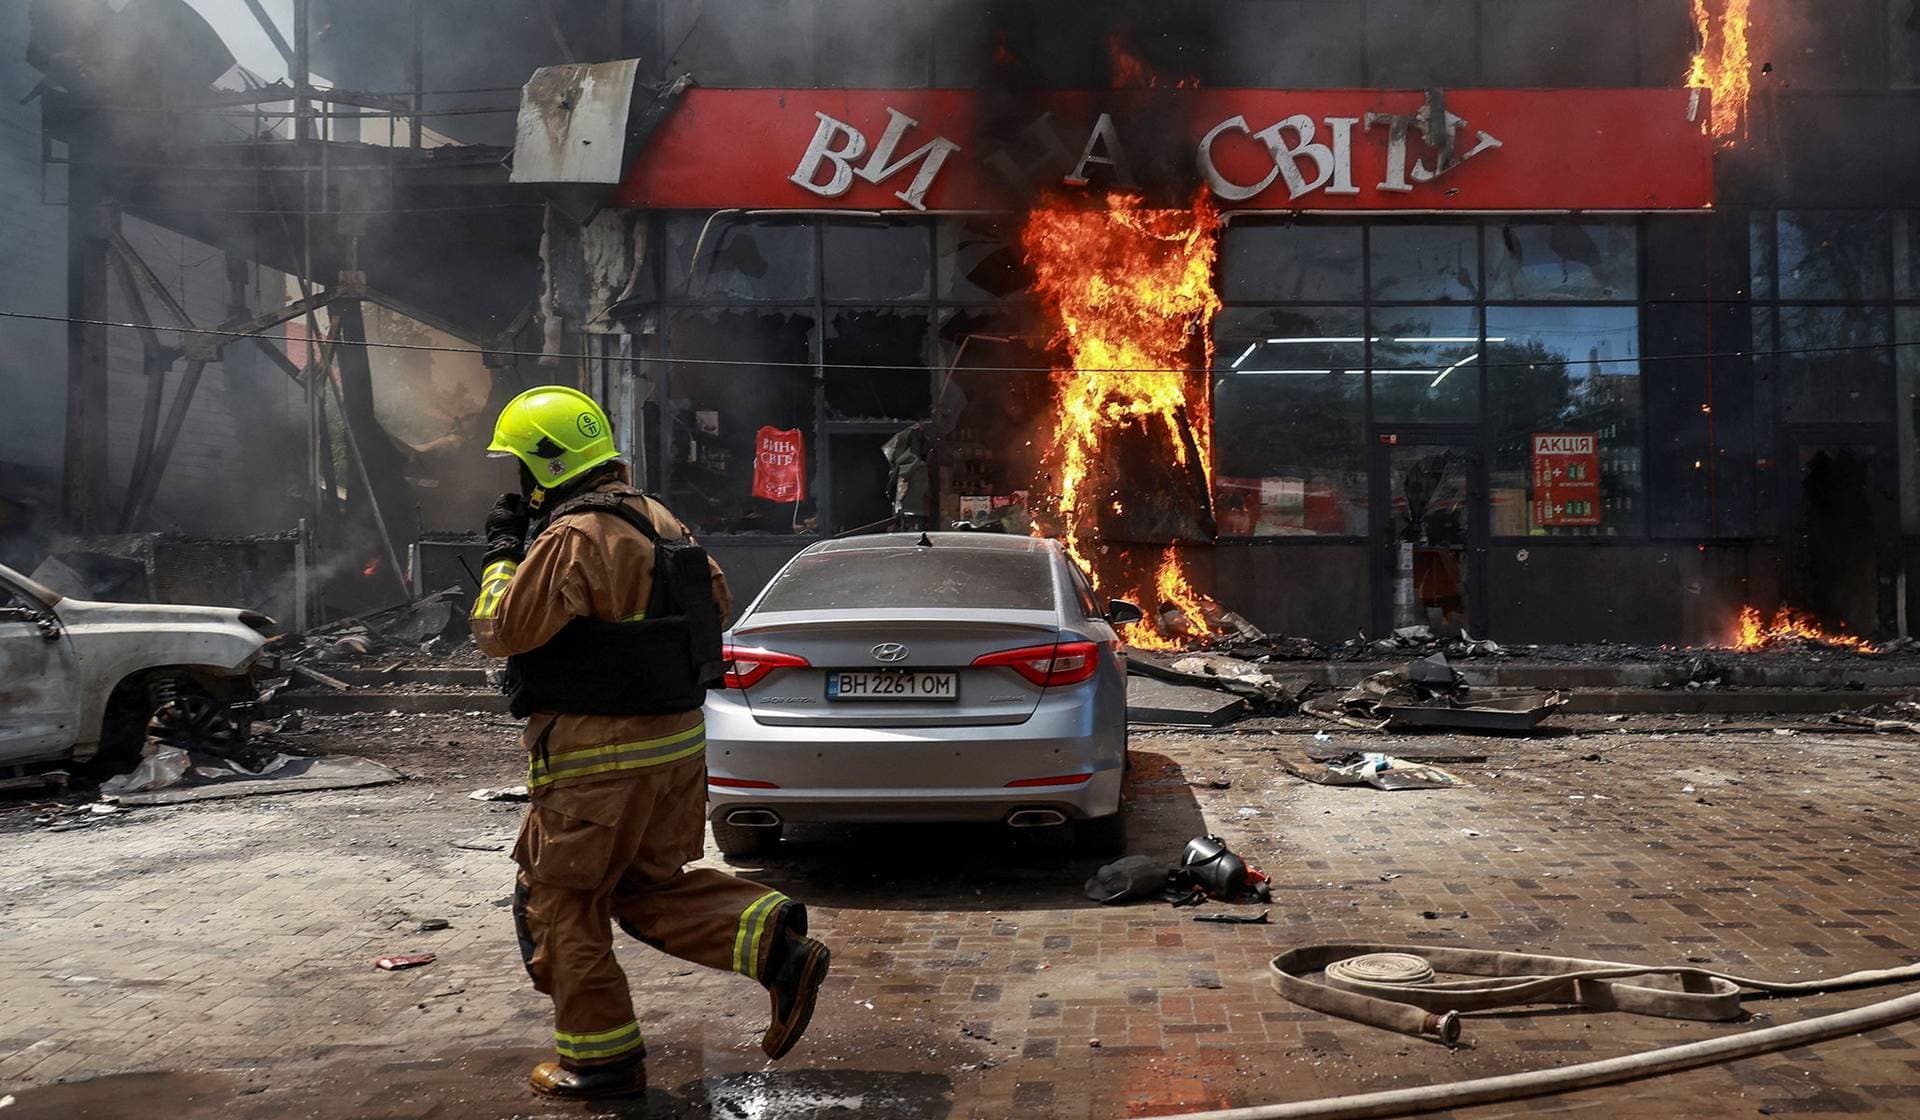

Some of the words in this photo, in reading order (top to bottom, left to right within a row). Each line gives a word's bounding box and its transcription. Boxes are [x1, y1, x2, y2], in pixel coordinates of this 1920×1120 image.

[583, 415, 591, 423] 6
[588, 425, 597, 434] 11
[1539, 438, 1590, 453] АКЦІЯ
[840, 675, 868, 694] BH
[872, 675, 915, 694] 2261
[921, 675, 951, 694] OM
